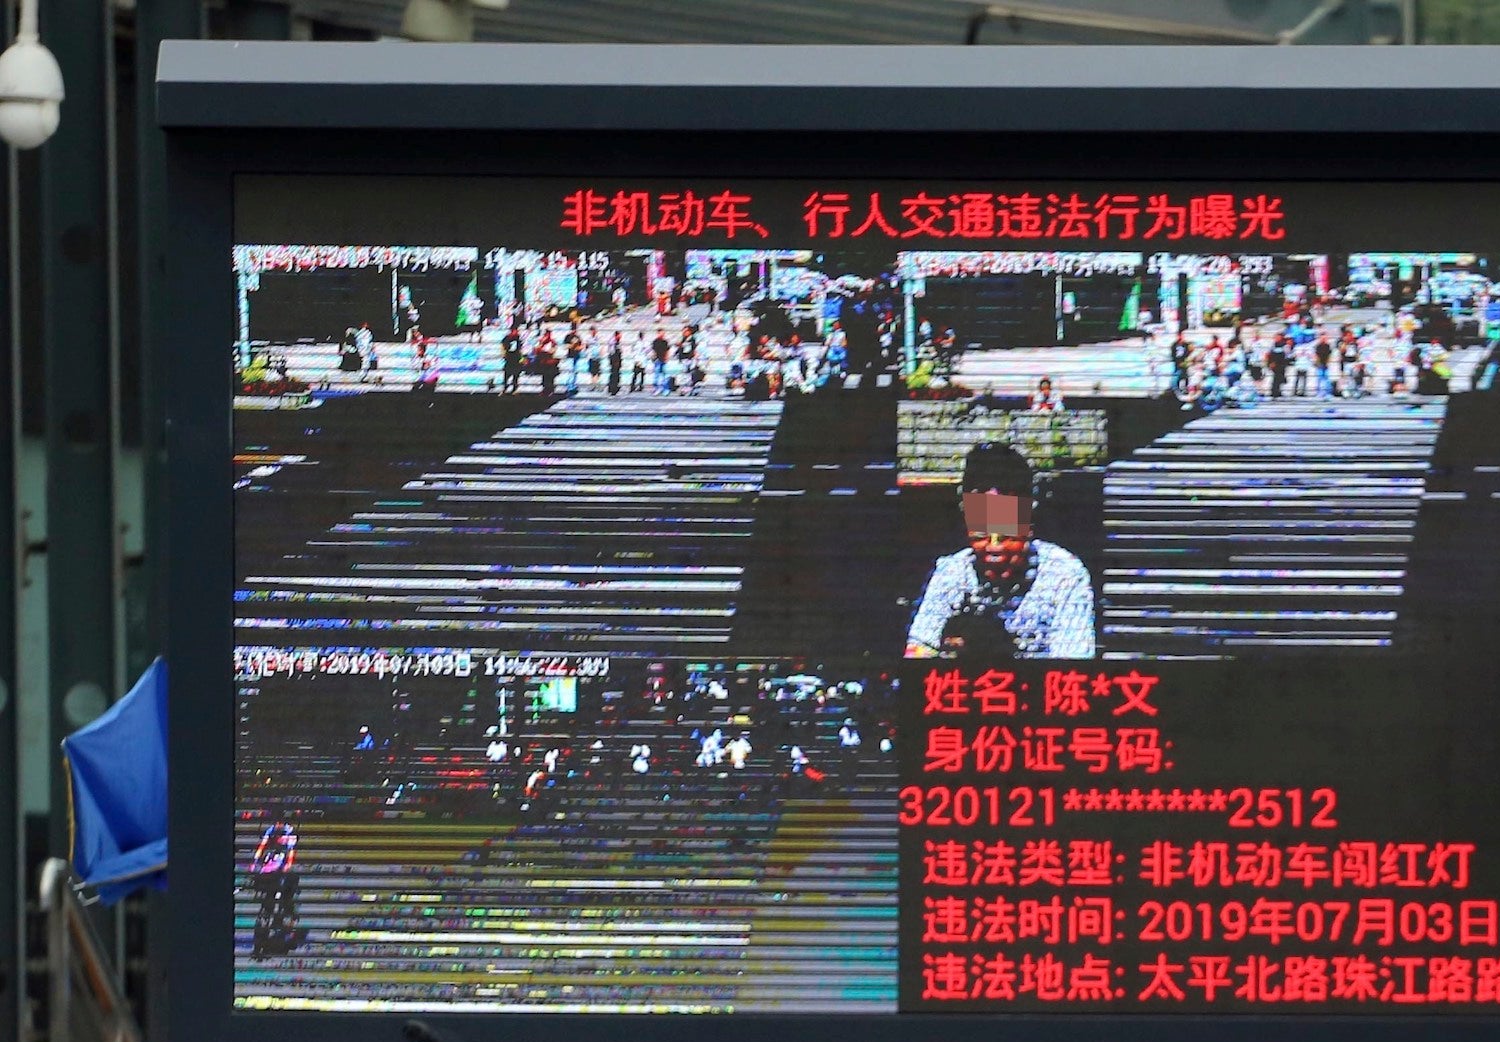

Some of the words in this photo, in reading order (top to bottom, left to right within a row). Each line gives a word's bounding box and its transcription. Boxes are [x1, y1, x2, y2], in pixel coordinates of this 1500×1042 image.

[561, 190, 1285, 240] 非机动车、行人交通违法行为曝光
[924, 669, 1028, 715] 姓名:
[924, 726, 1173, 773] 身份证号码:
[923, 839, 1125, 886] 违法类型:
[1139, 840, 1475, 888] 非机动车闯红灯
[922, 895, 1125, 944] 违法时间:
[1138, 897, 1498, 946] 2019年07月03日
[922, 952, 1125, 1001] 违法地点:
